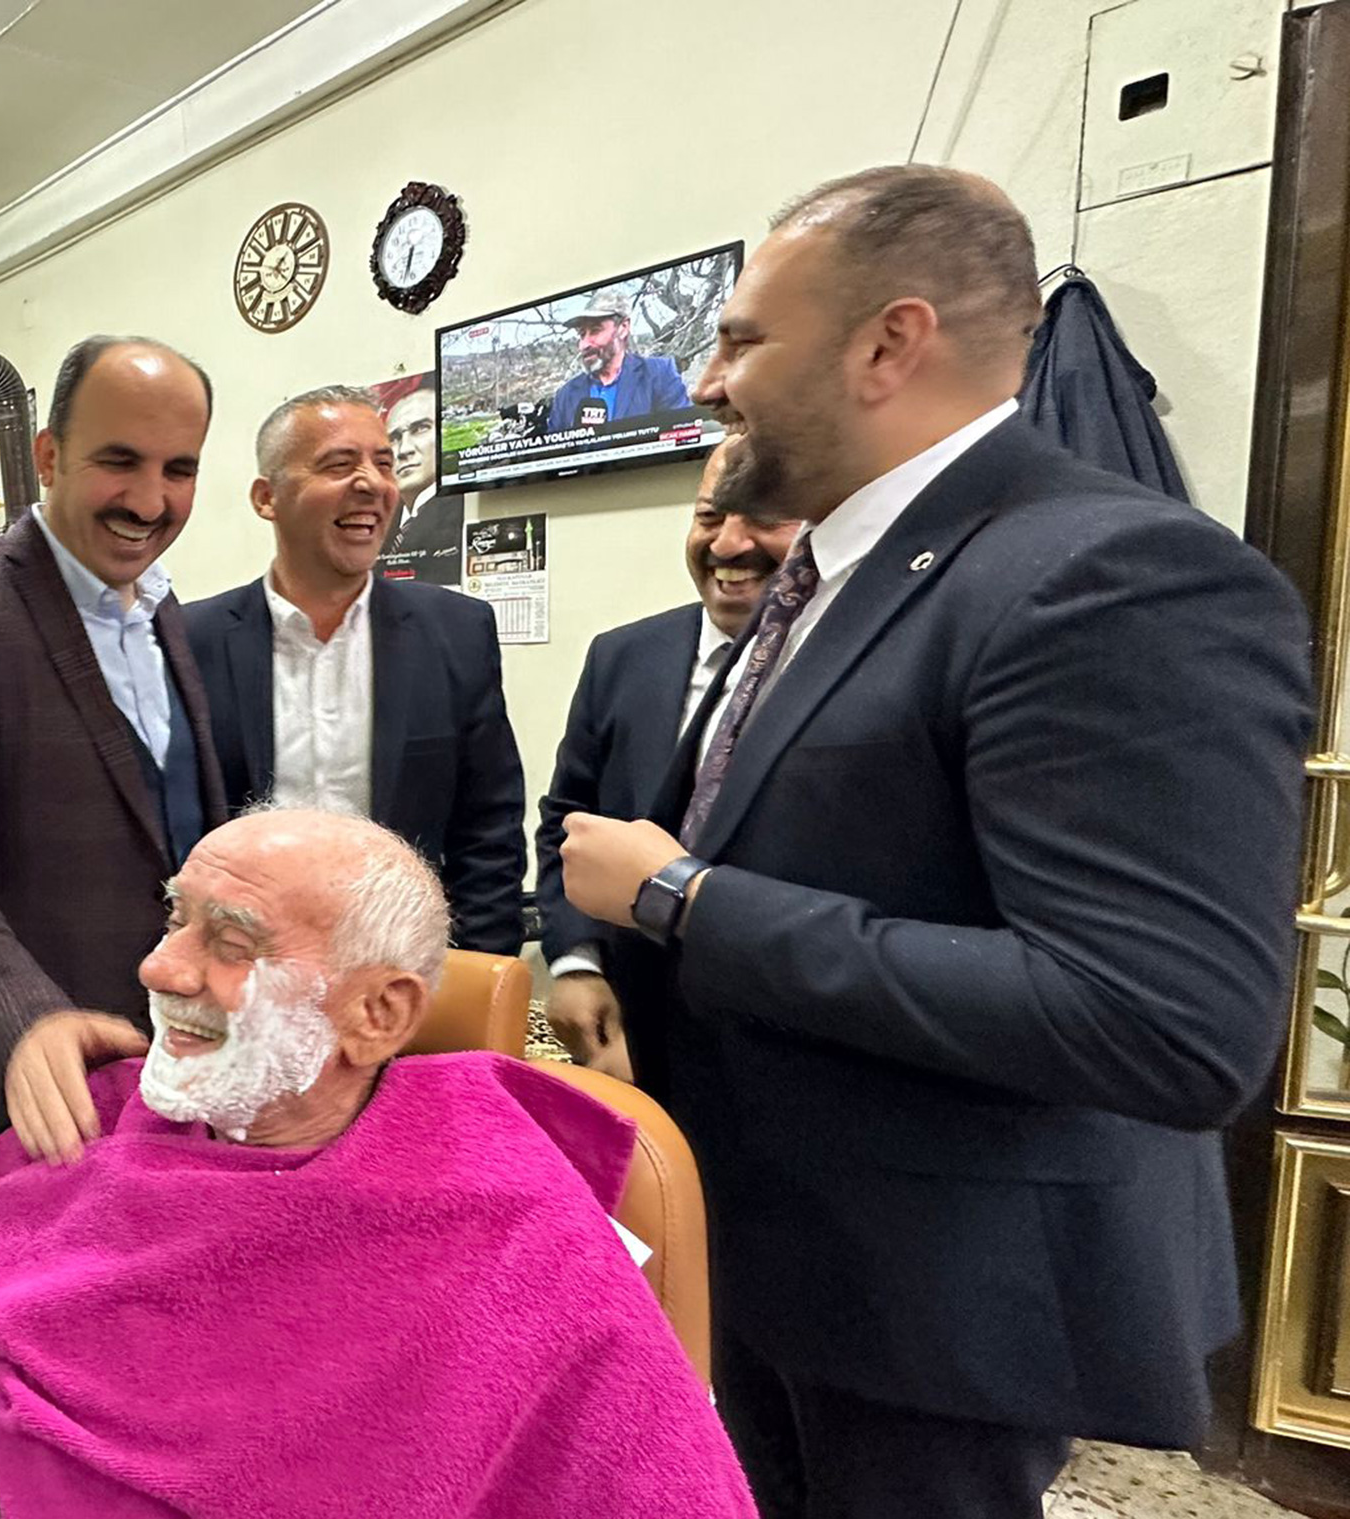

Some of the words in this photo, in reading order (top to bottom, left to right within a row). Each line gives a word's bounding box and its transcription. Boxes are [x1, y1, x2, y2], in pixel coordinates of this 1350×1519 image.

[582, 407, 606, 419] TRT
[638, 427, 660, 436] TUTTU
[458, 443, 508, 459] YÖRÜKLER
[509, 435, 543, 451] YAYLA
[543, 426, 596, 444] YOLUNDA
